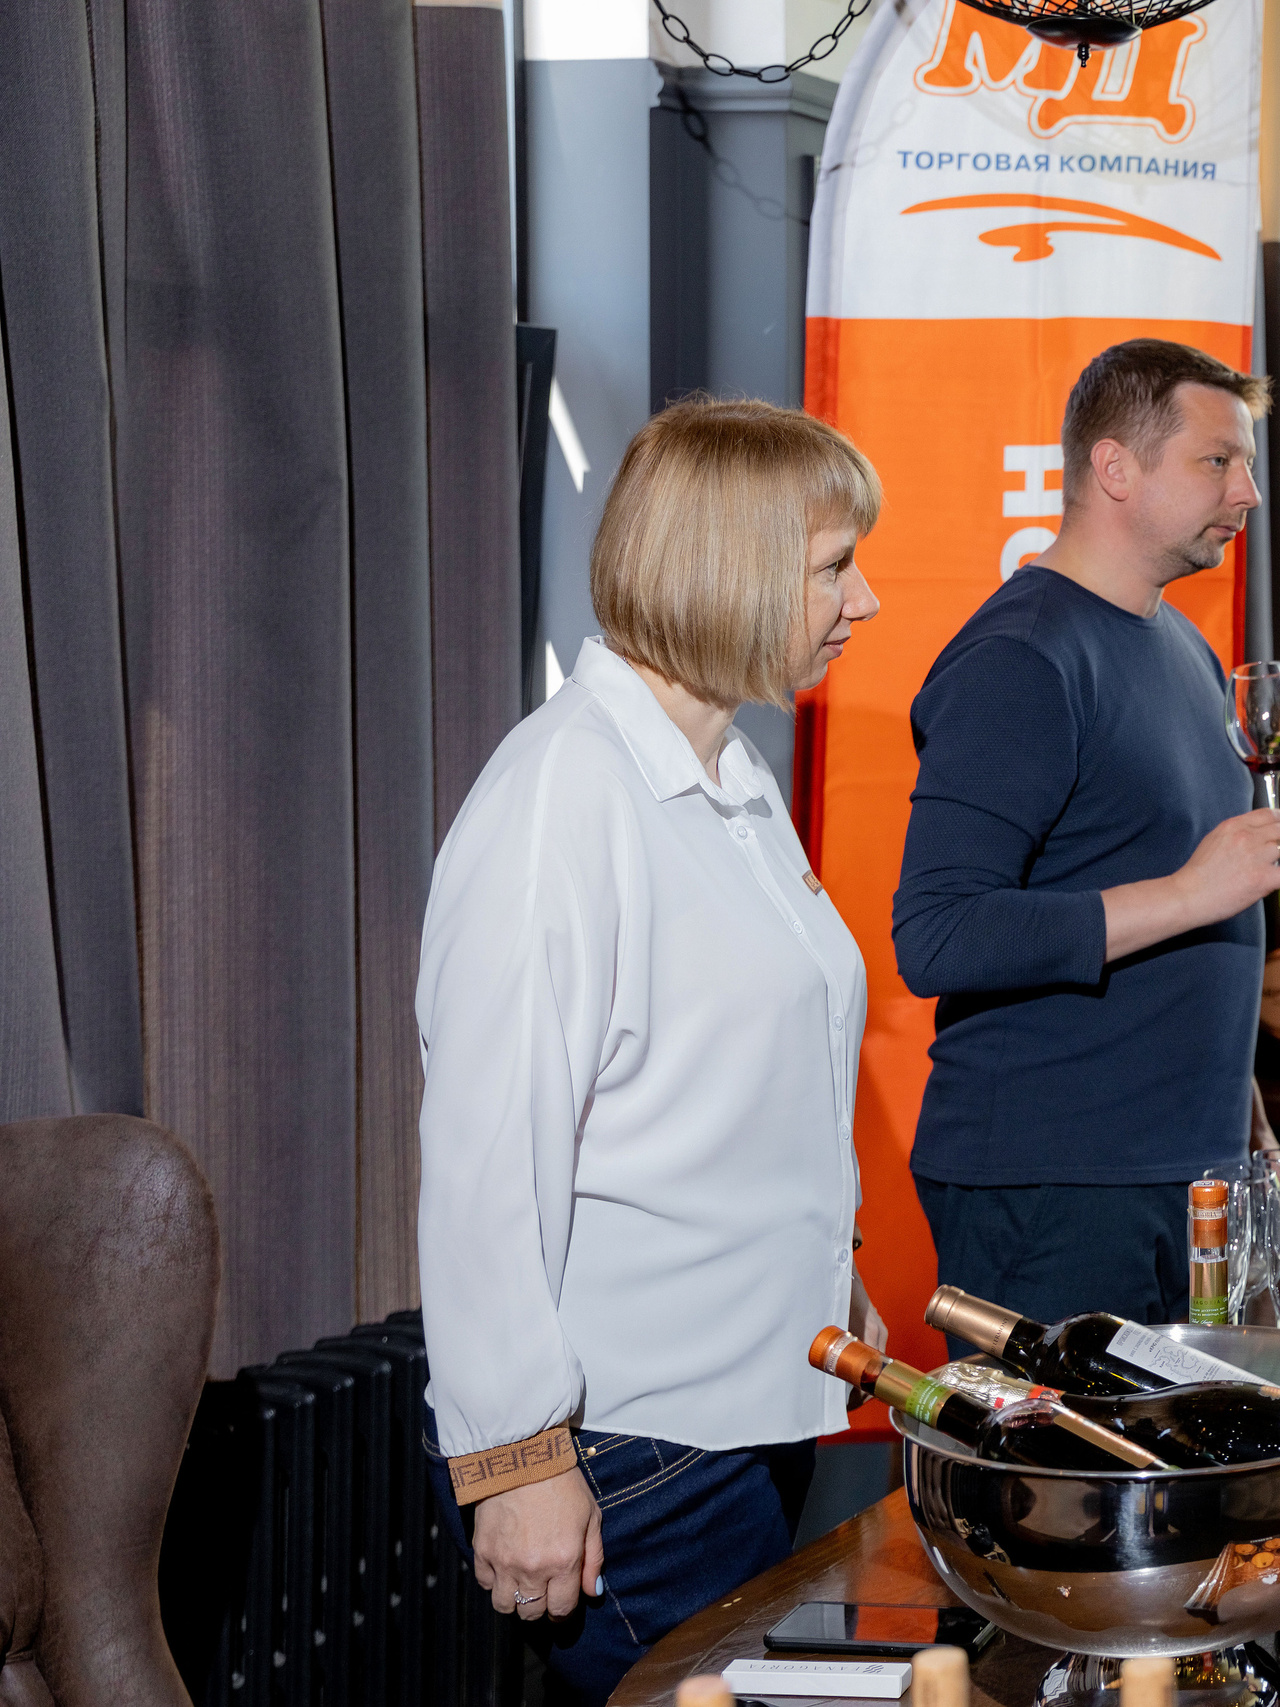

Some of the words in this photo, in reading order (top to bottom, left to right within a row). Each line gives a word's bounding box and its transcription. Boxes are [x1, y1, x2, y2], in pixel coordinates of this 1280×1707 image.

[897, 150, 1050, 173] ТОРГОВАЯ
[1059, 153, 1217, 181] КОМПАНИЯ
[749, 1663, 861, 1672] FANAGORIA
